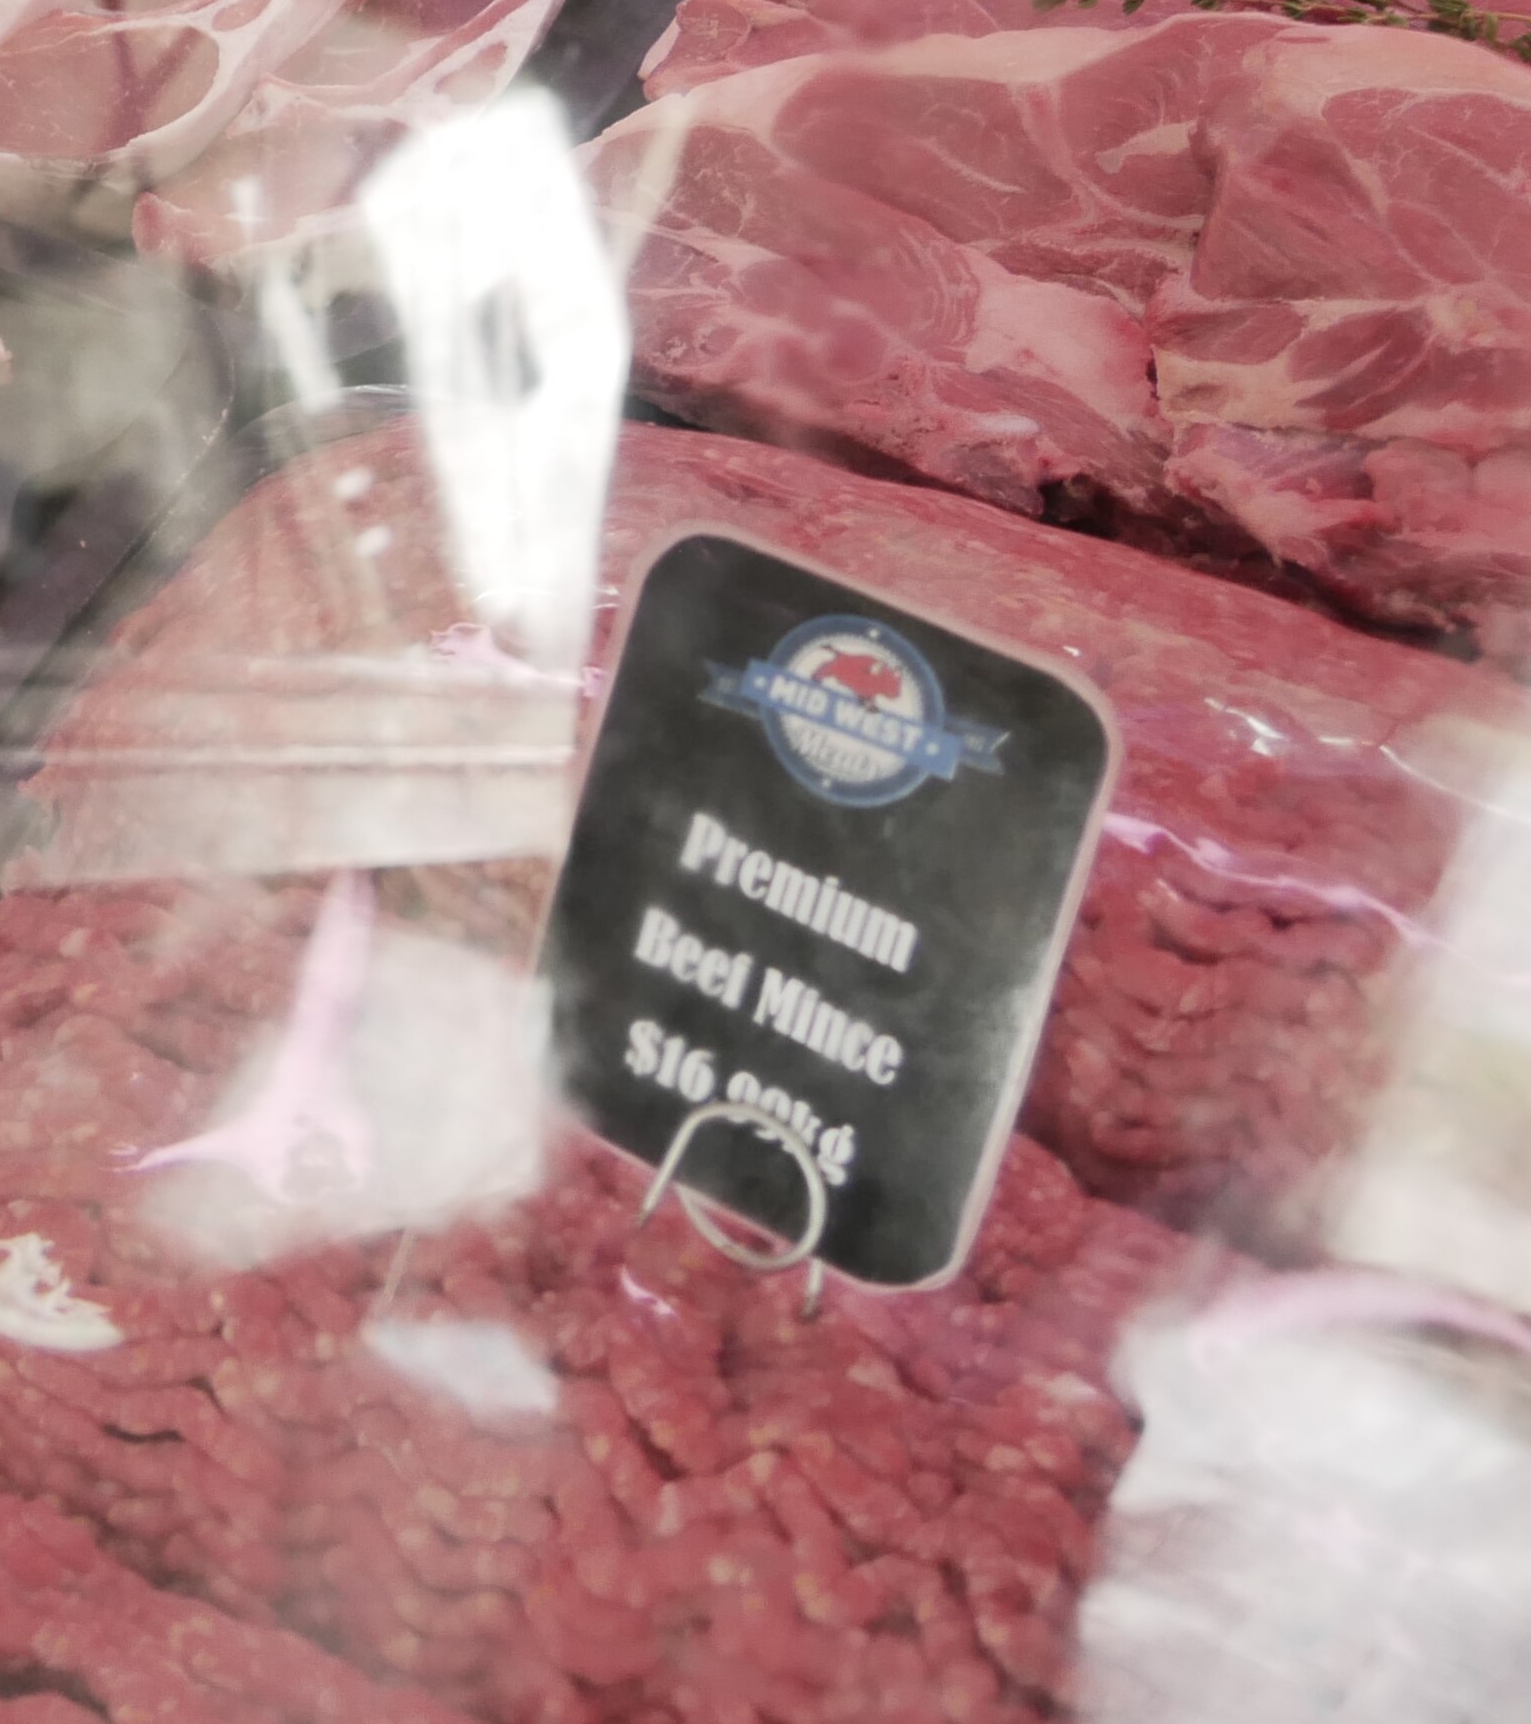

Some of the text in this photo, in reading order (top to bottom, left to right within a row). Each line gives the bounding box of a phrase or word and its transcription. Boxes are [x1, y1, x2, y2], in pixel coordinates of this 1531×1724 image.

[768, 675, 828, 718] MID
[832, 699, 924, 753] WEST
[677, 811, 922, 975] Premium
[631, 903, 908, 1089] Beef Mince
